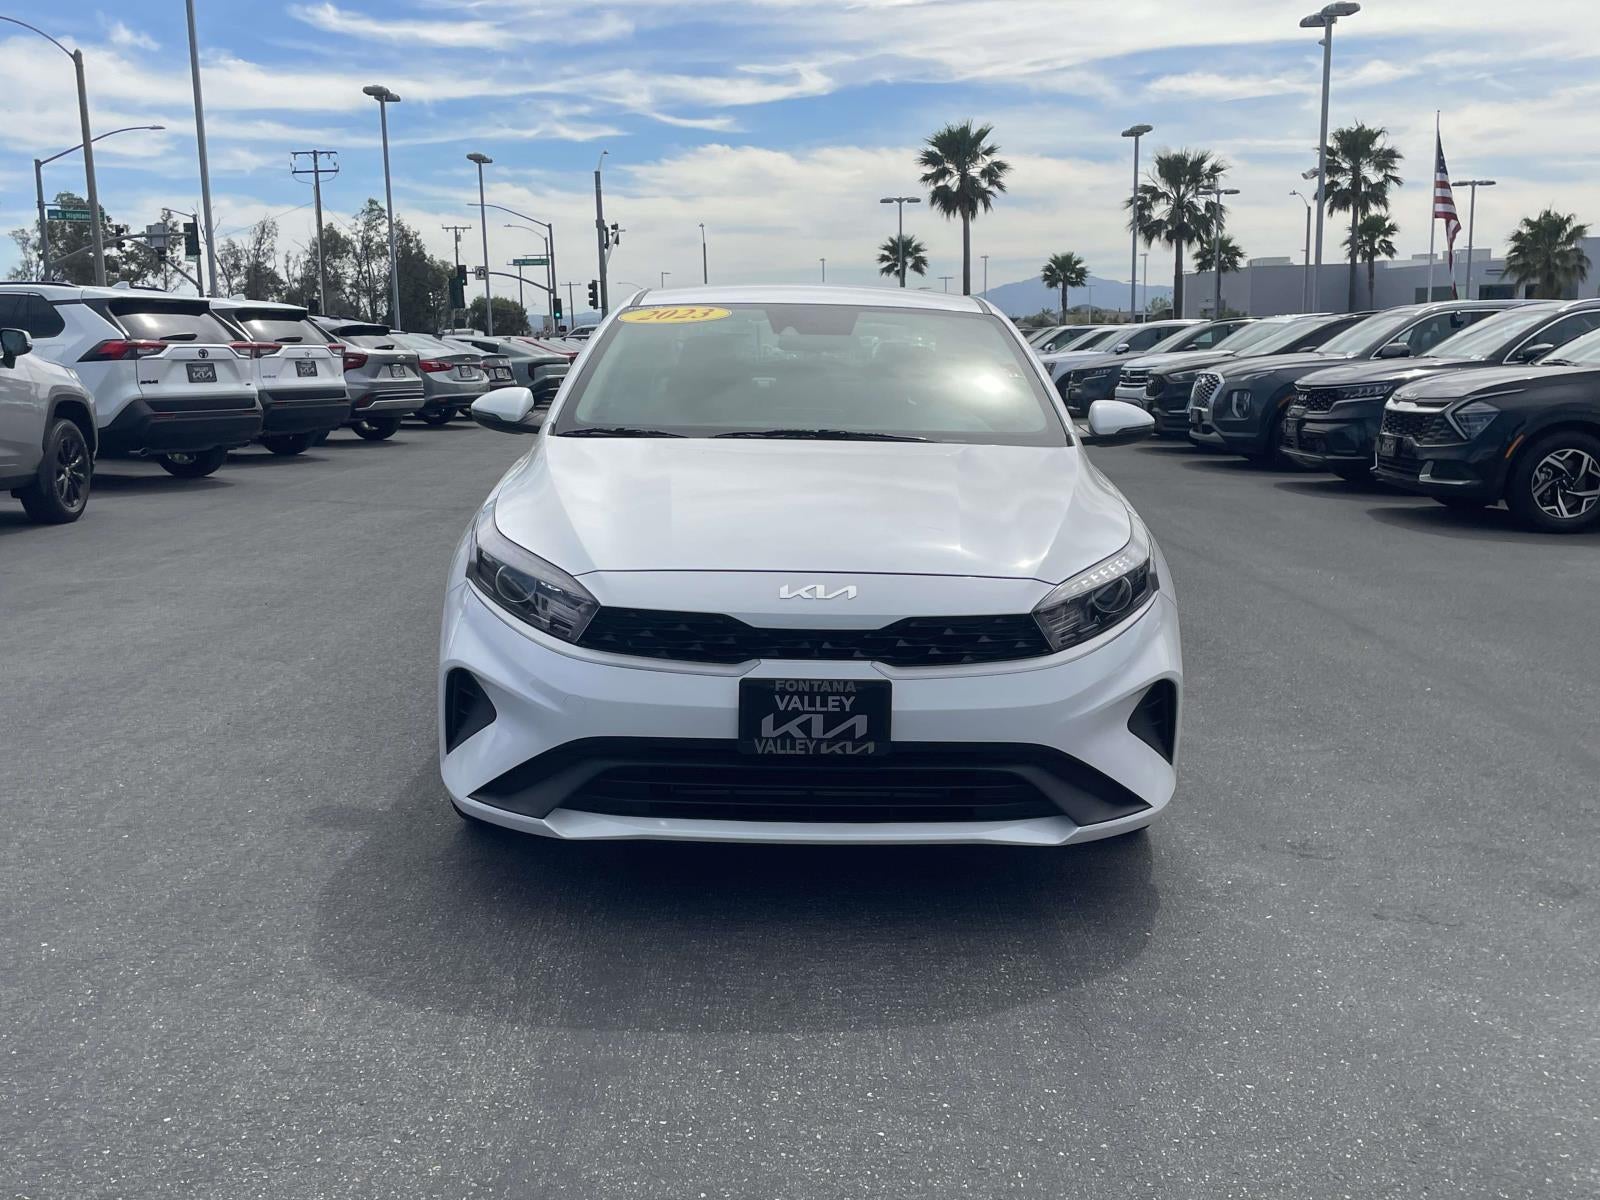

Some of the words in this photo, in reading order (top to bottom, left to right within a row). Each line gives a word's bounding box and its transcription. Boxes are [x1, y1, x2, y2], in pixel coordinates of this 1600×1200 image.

[637, 305, 714, 321] 2023
[779, 584, 857, 600] KIA
[774, 679, 857, 693] FONTANA
[774, 694, 856, 712] VALLEY
[761, 712, 868, 739] KIA
[754, 738, 817, 755] VALLEY
[820, 741, 875, 755] KIA
